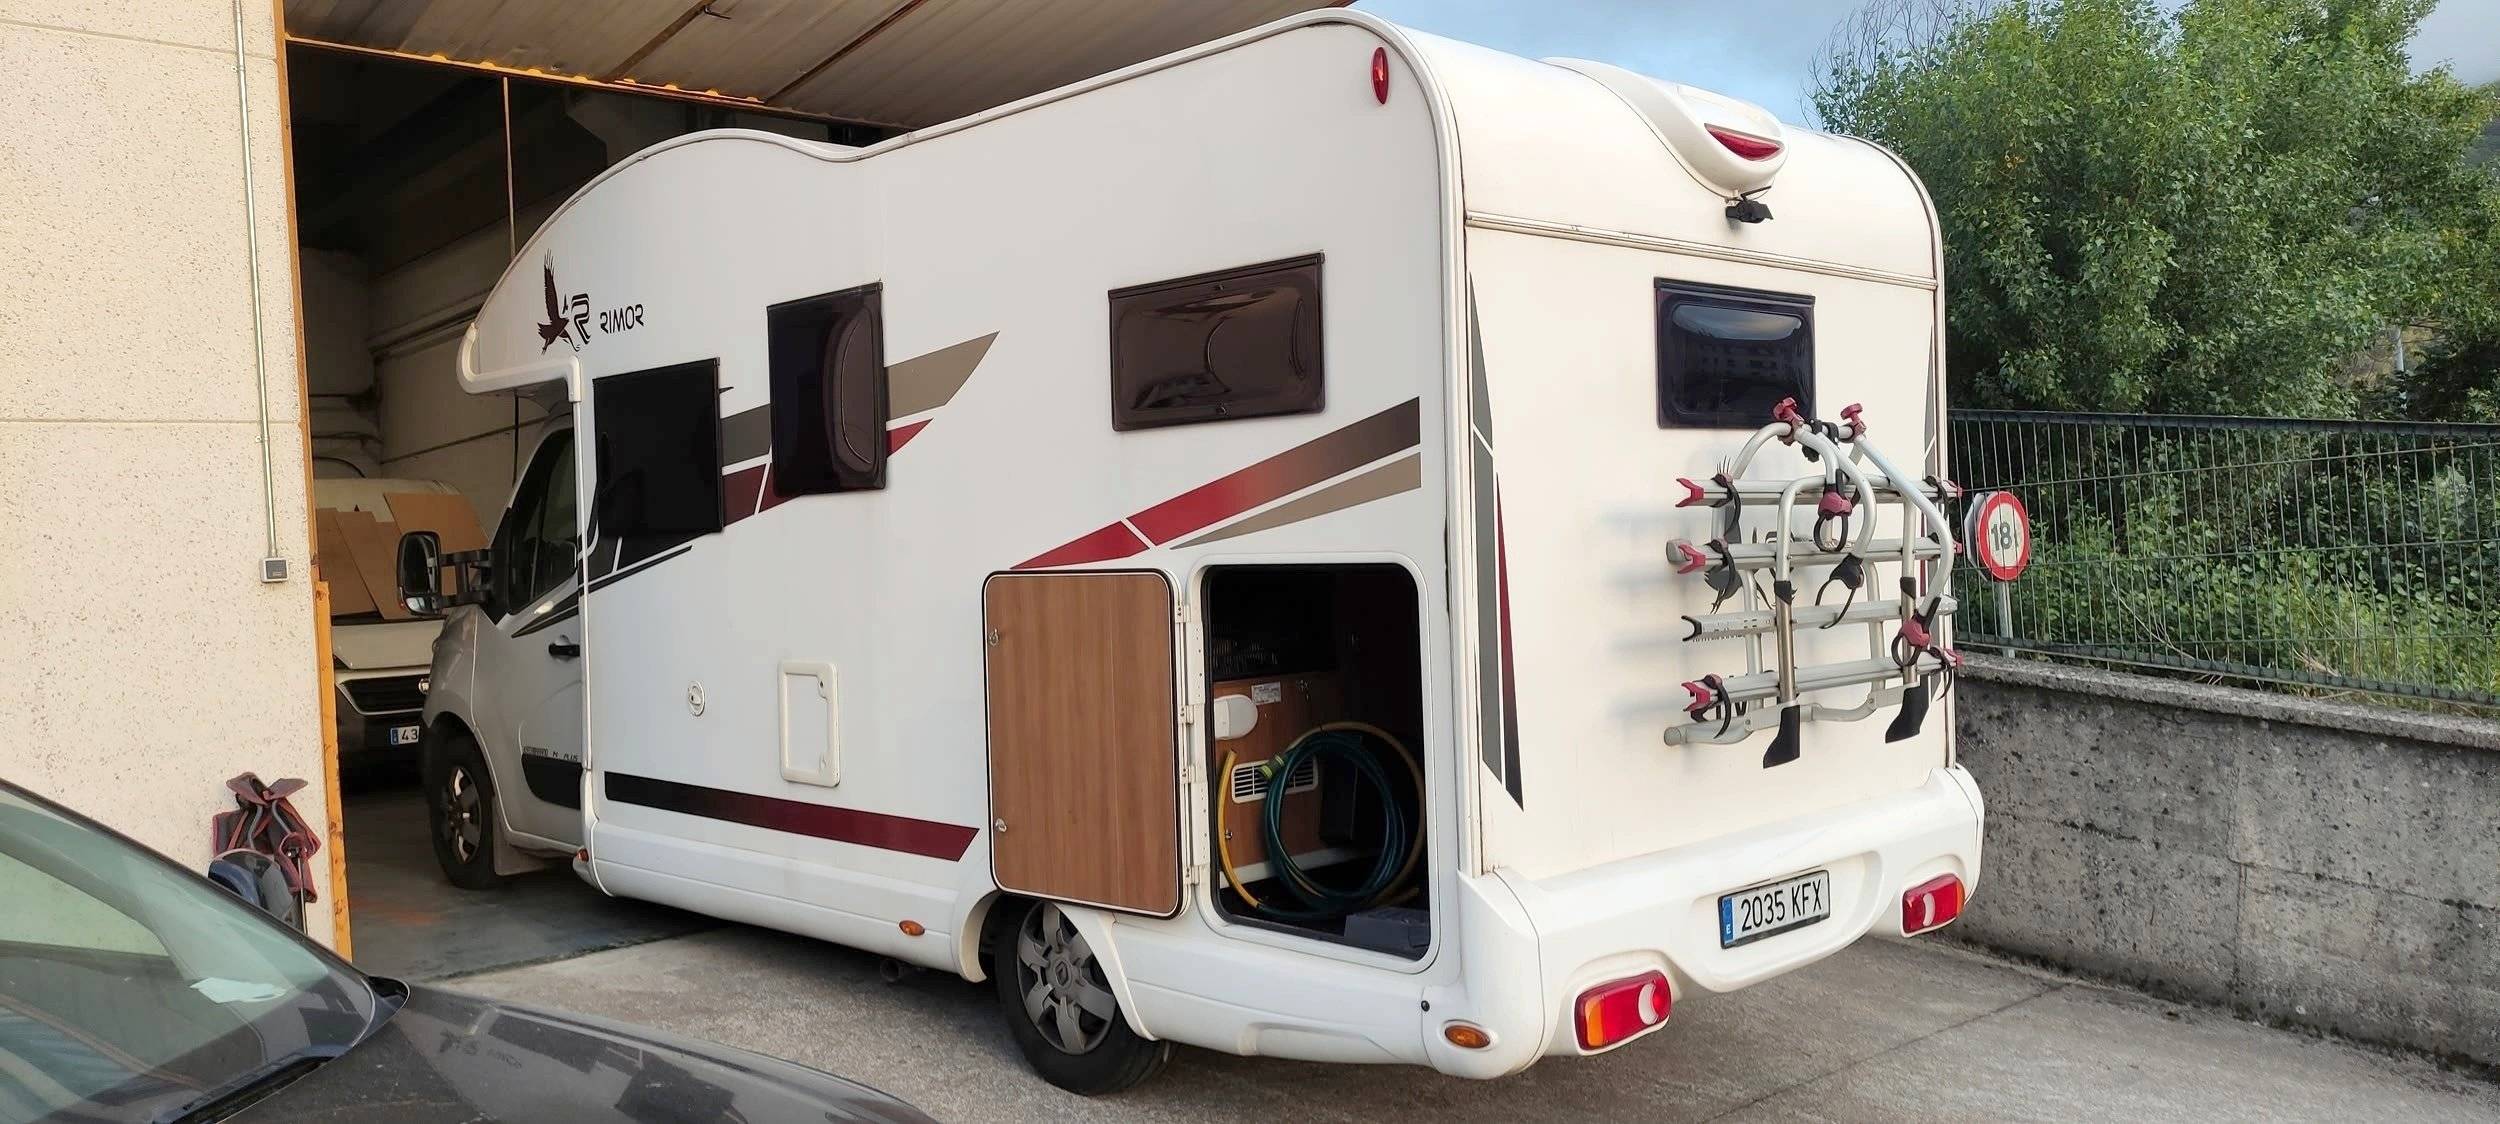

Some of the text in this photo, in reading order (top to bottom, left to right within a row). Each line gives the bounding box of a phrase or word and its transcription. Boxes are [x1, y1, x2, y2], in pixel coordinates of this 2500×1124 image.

[600, 303, 645, 334] RIMOR
[1741, 890, 1786, 932] 2035
[1791, 878, 1822, 918] KFX
